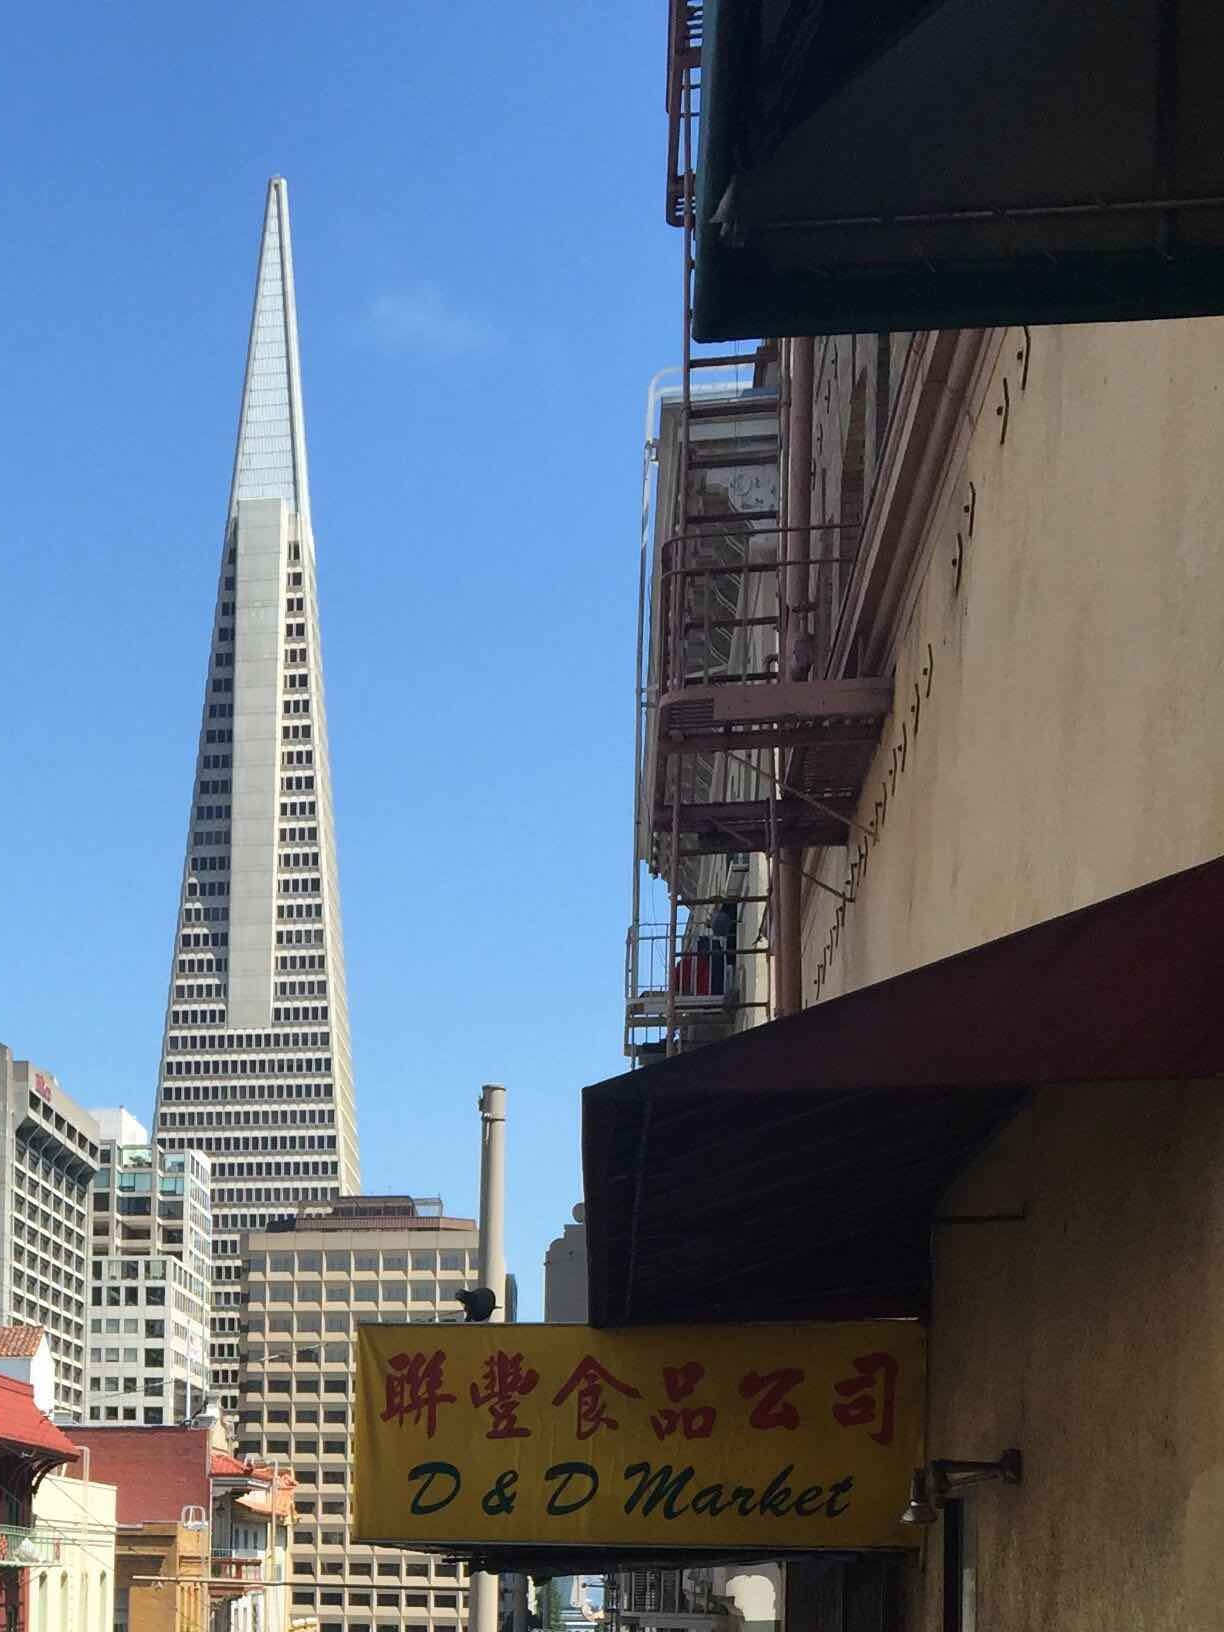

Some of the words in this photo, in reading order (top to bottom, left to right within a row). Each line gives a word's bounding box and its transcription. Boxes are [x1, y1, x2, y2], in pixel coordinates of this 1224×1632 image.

[379, 1348, 901, 1446] 聯豐食品公司
[407, 1461, 462, 1517] D
[480, 1468, 519, 1516] &
[543, 1461, 600, 1517] D
[623, 1461, 854, 1520] Market
